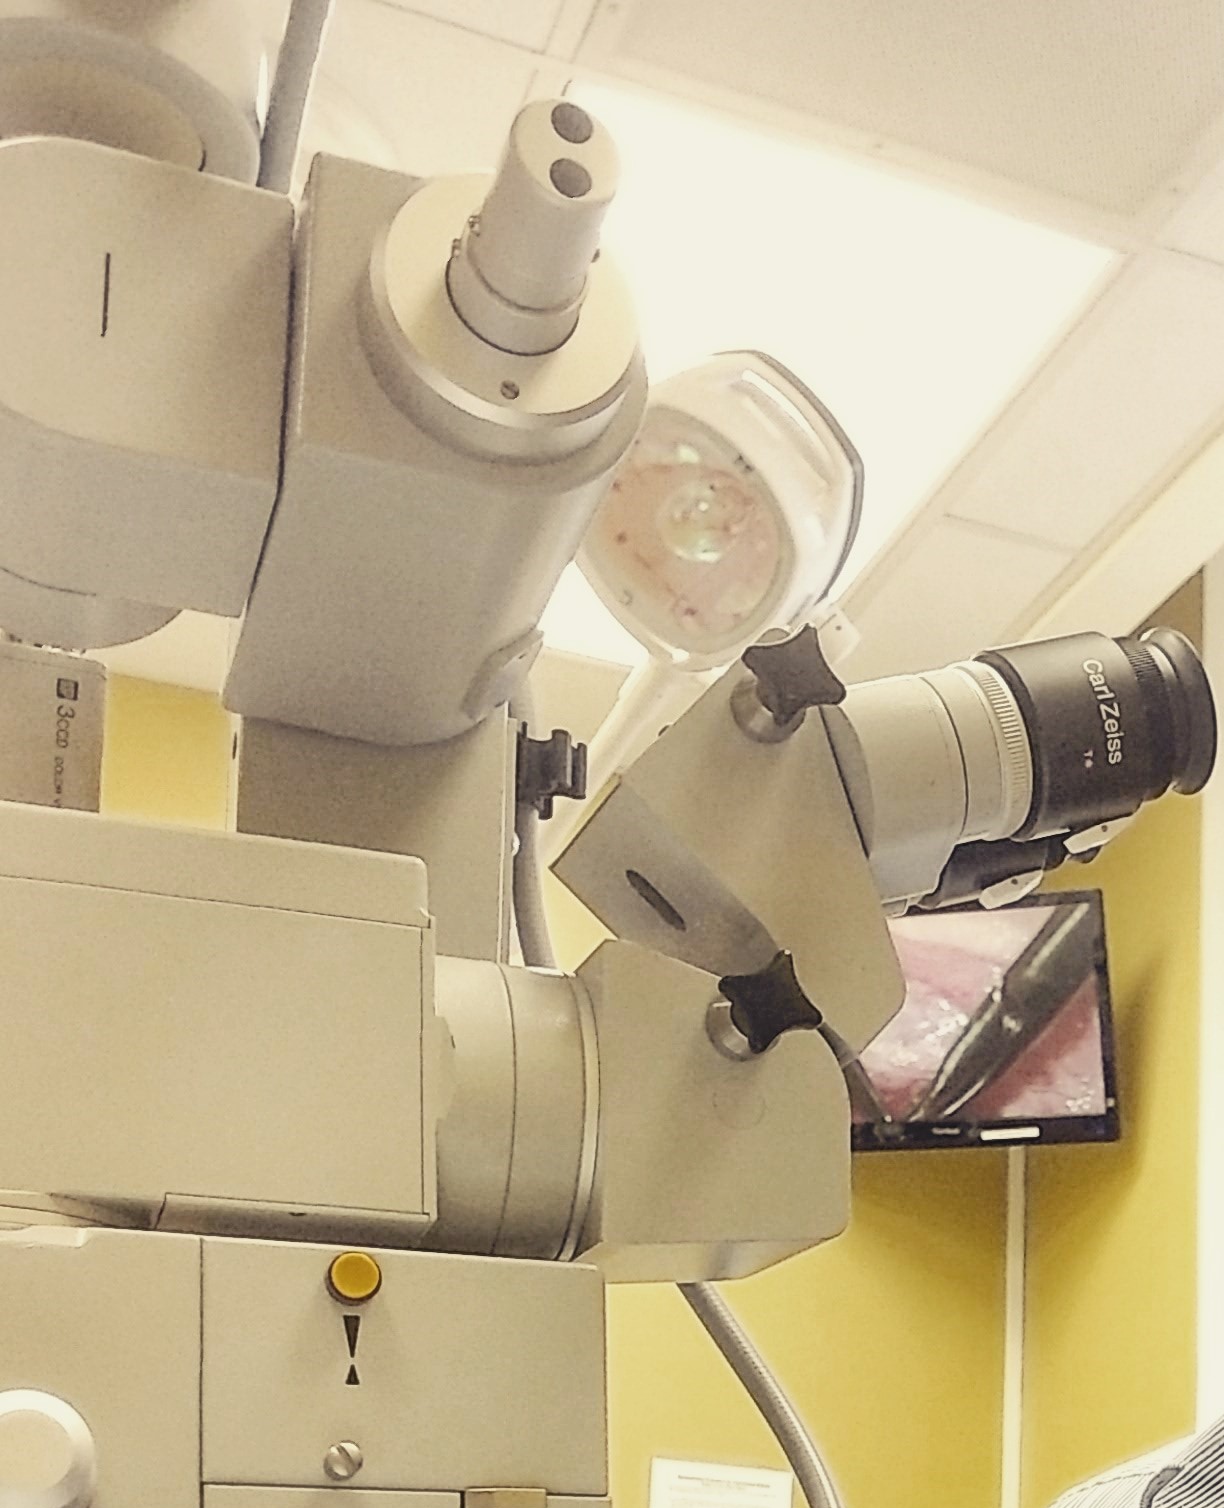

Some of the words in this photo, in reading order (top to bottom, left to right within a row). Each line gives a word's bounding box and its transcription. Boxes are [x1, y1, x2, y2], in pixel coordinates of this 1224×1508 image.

[56, 705, 76, 749] 3CCD
[1082, 658, 1116, 701] Carl
[1099, 702, 1125, 765] Zeiss
